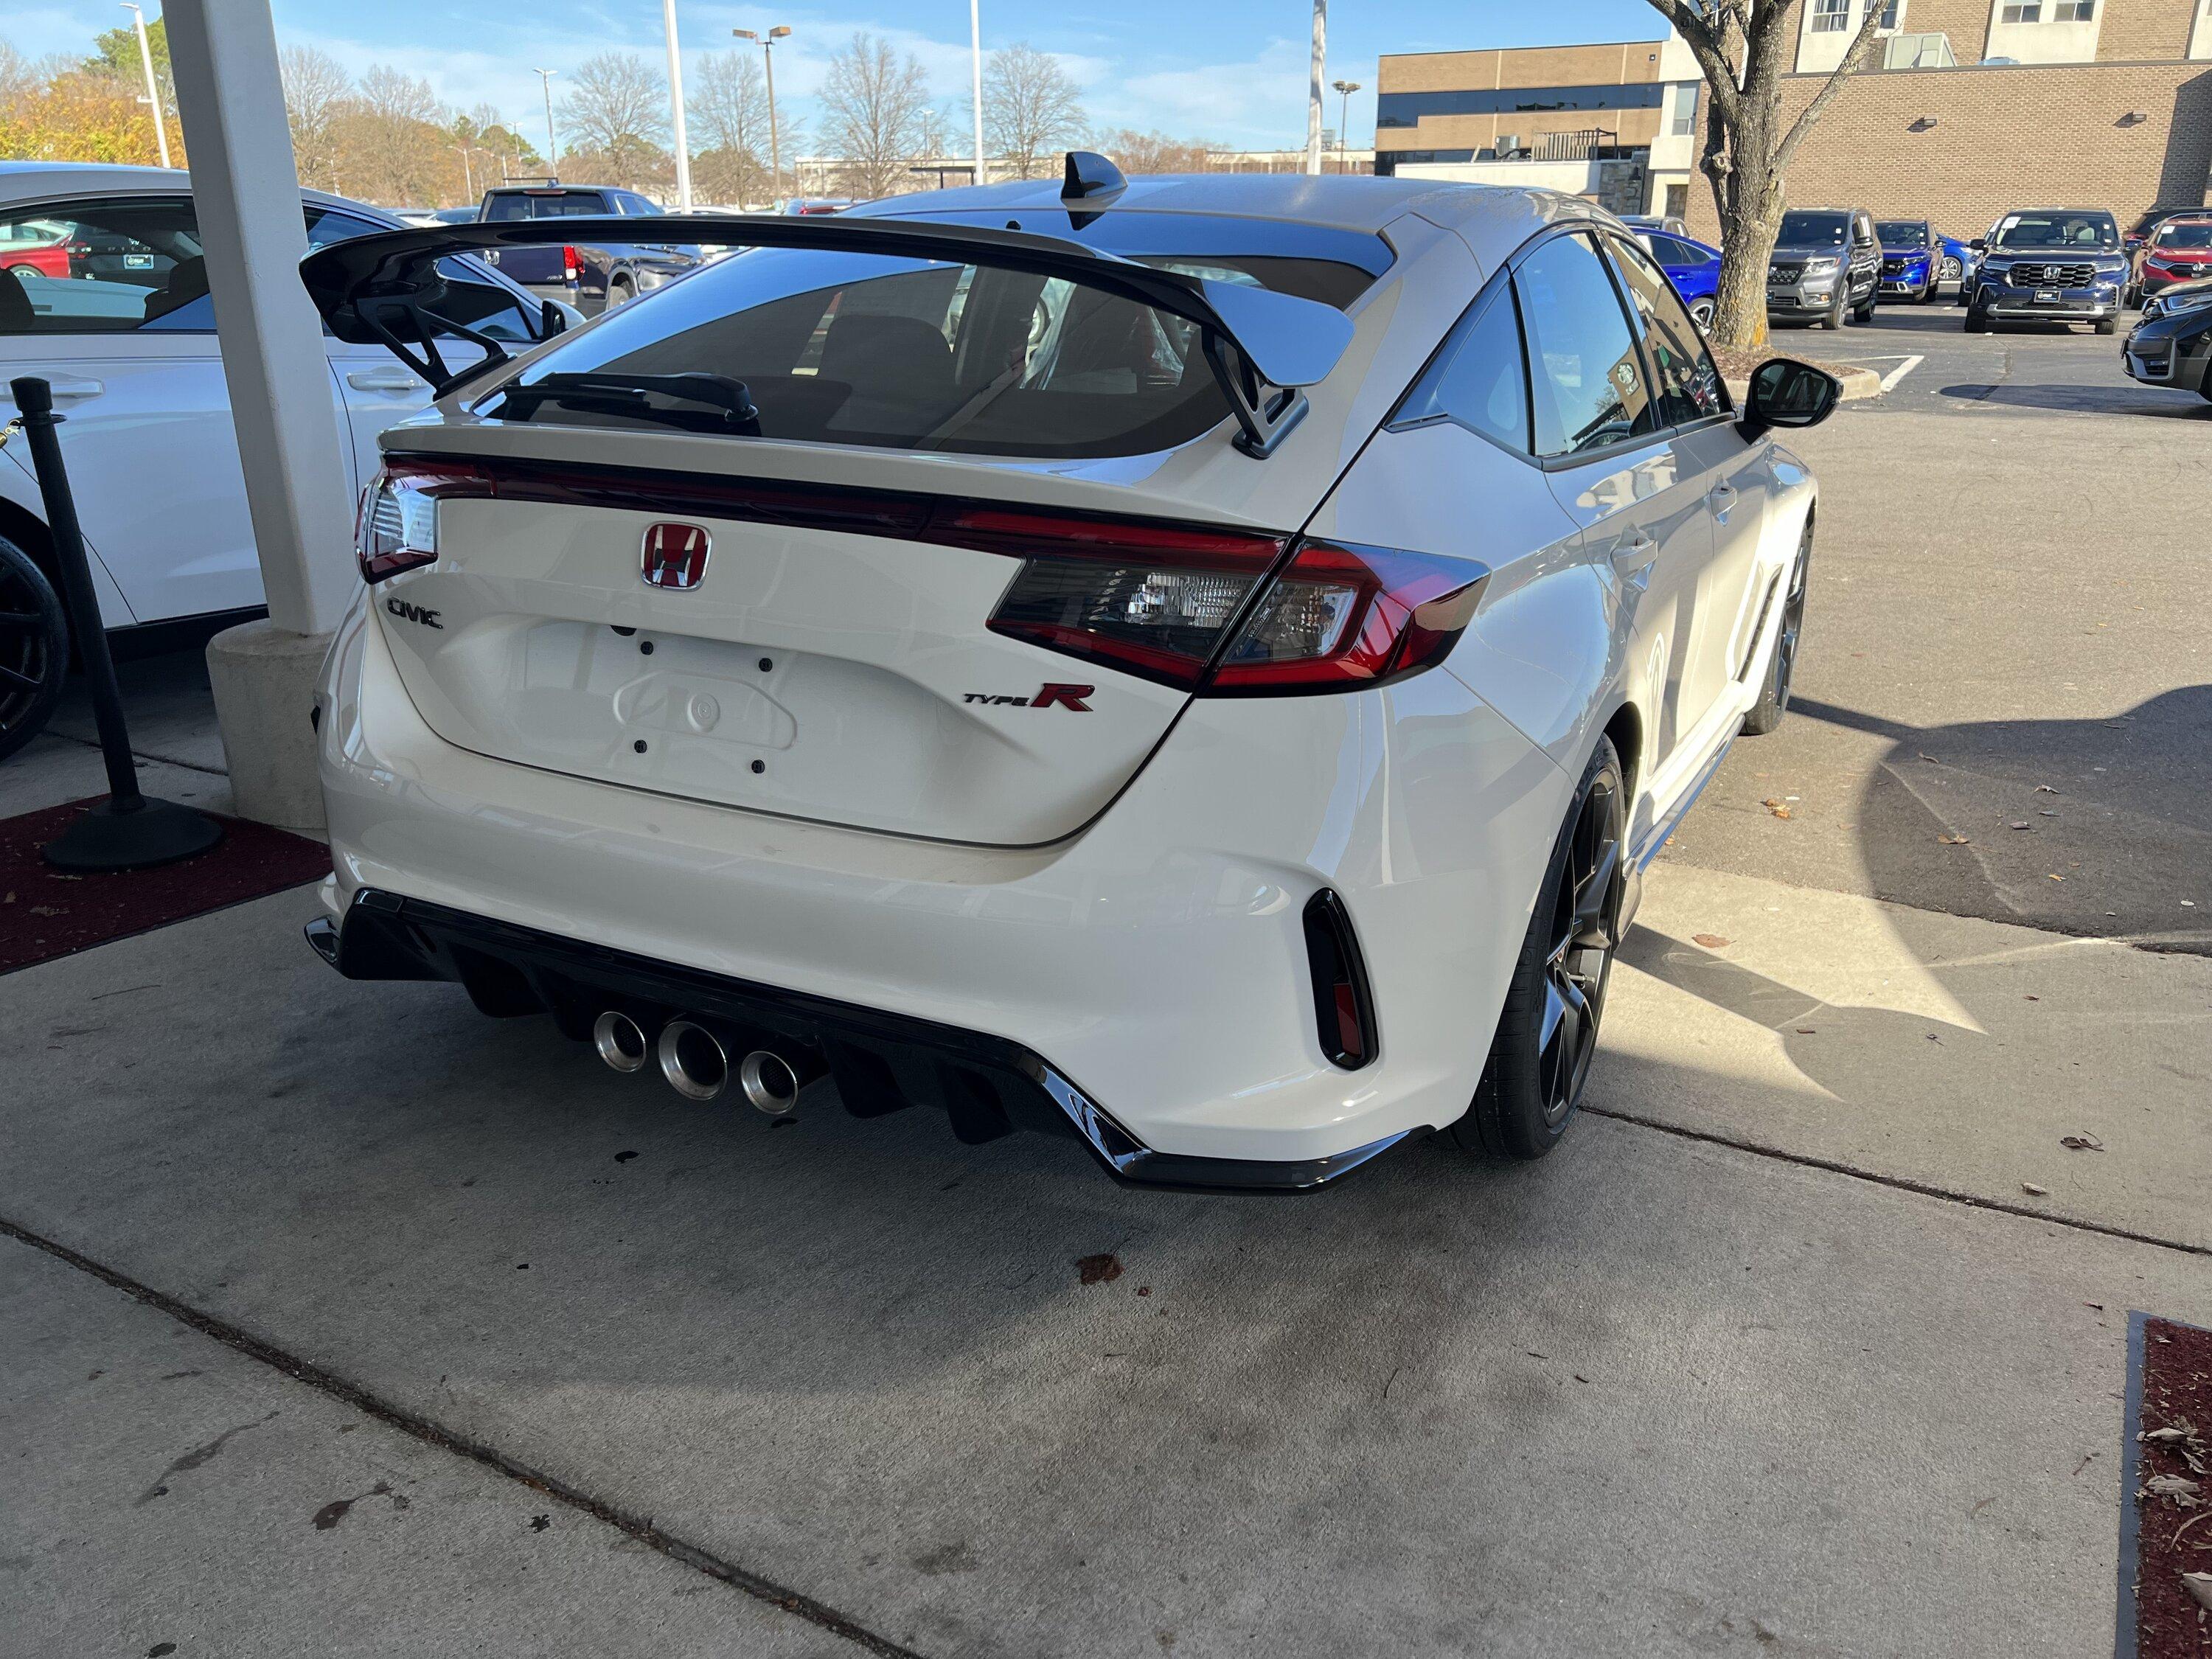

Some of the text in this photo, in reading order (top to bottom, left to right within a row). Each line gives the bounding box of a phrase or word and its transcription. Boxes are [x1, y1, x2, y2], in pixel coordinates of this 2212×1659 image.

[387, 597, 443, 629] CIVIC
[964, 683, 1096, 712] TYPE R
